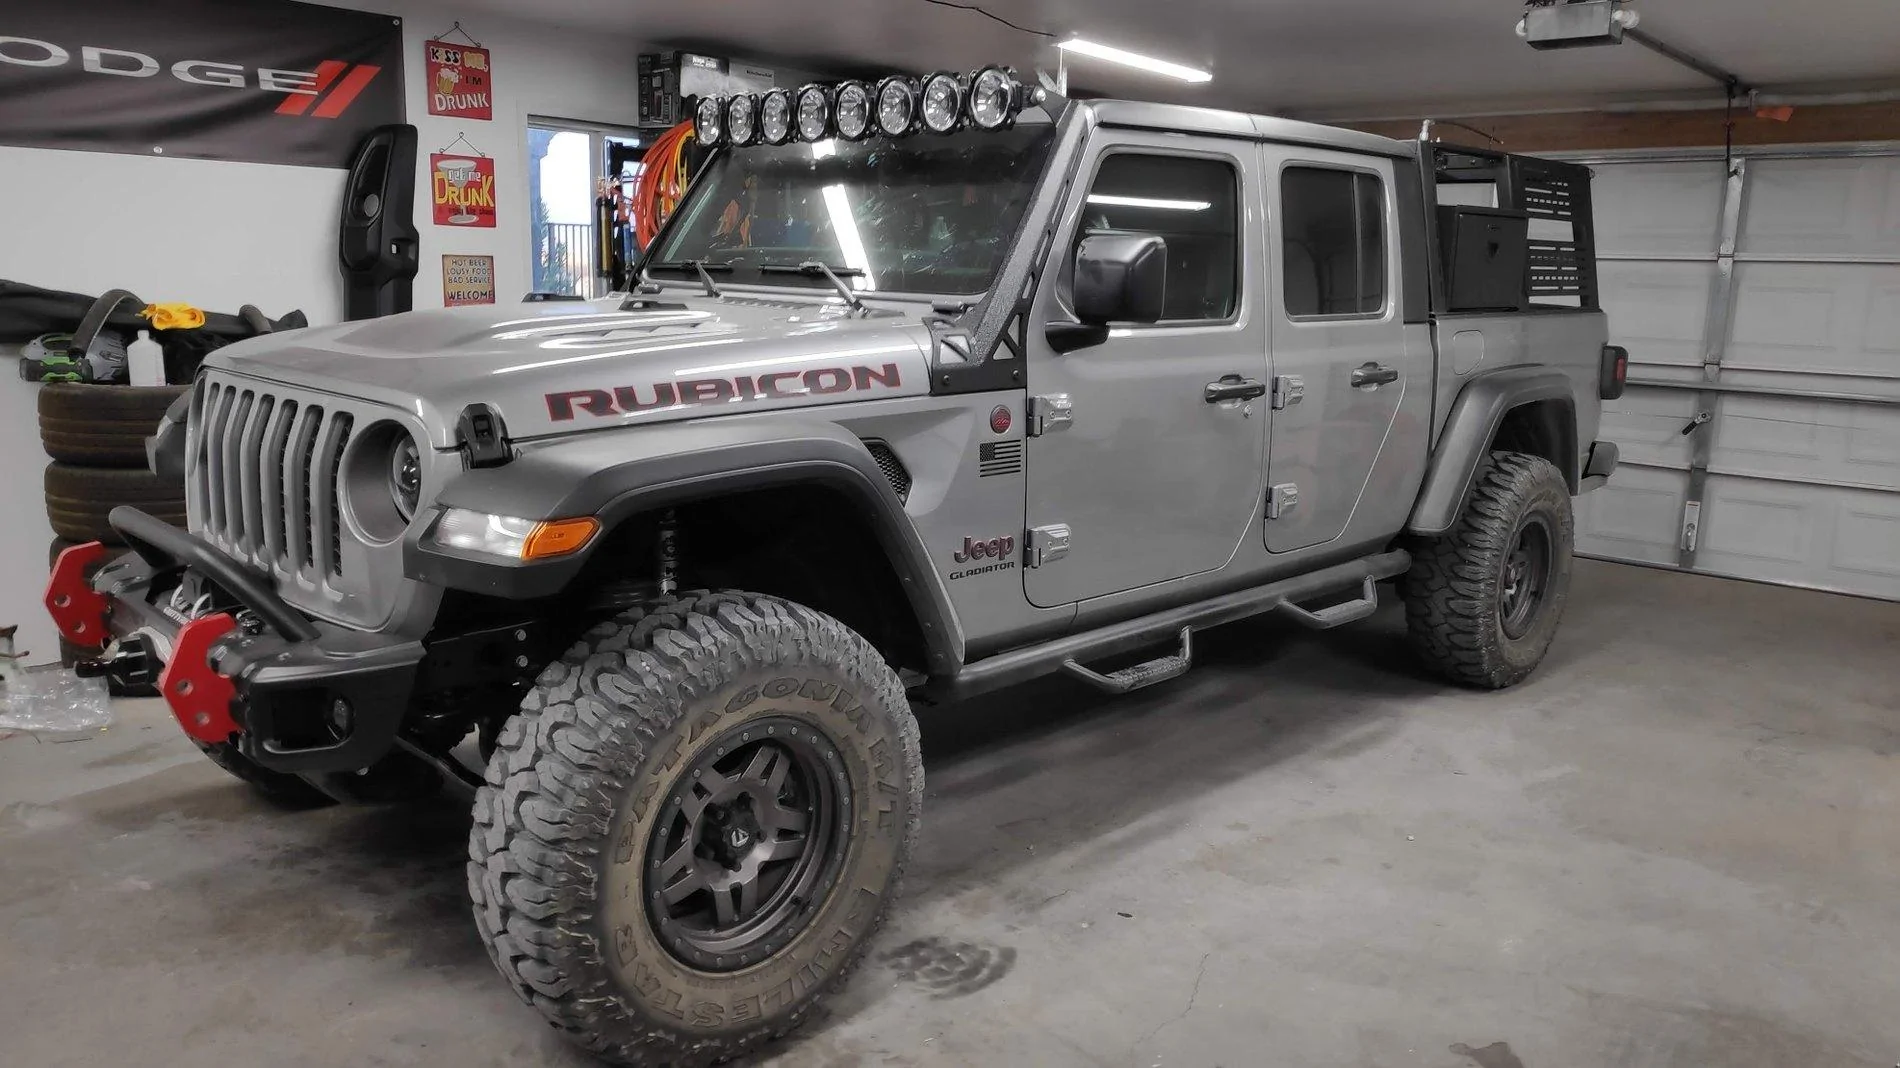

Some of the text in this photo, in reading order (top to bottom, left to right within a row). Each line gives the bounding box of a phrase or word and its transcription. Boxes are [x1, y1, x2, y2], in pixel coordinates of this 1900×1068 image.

[434, 93, 490, 111] DRUNK
[448, 167, 481, 183] get me
[433, 171, 495, 208] DRUNK
[447, 276, 464, 284] BAD
[447, 290, 493, 301] WELCOME
[545, 363, 901, 422] RUBICON
[953, 535, 1015, 564] Jeep
[949, 561, 1015, 580] GLADIATOR
